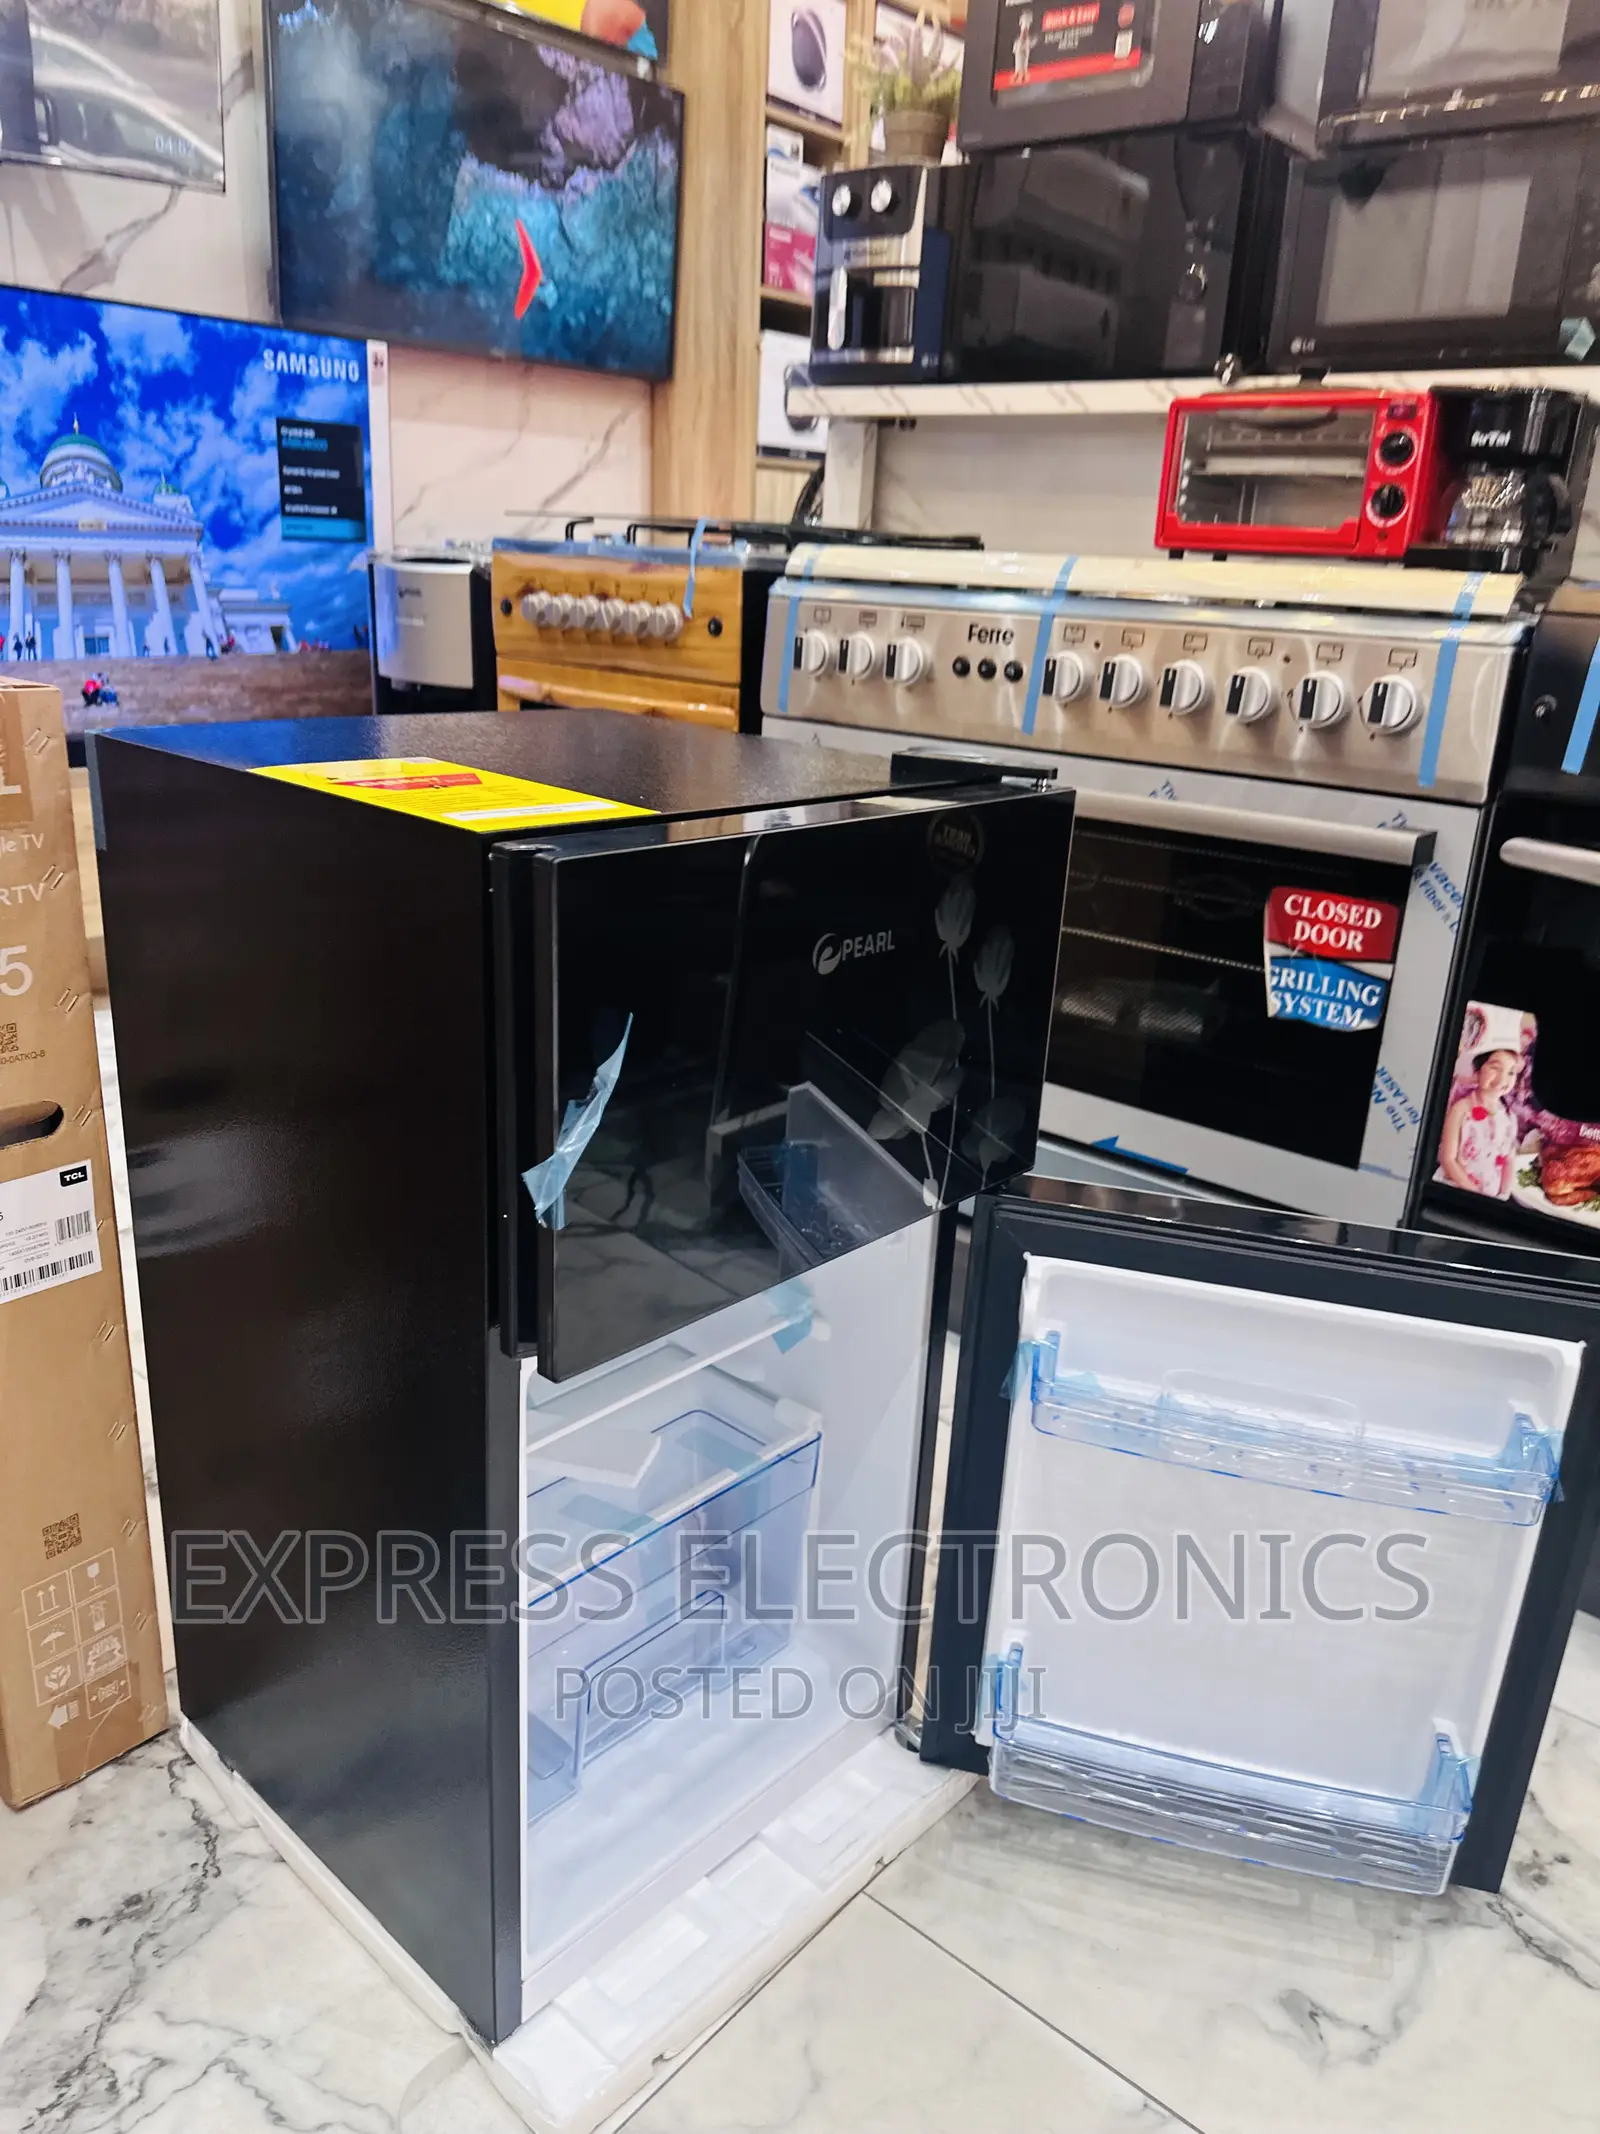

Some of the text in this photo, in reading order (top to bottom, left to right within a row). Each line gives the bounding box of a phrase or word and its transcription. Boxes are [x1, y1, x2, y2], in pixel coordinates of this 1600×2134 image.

[263, 348, 360, 383] SAMSUNG
[20, 833, 44, 850] TV
[1284, 894, 1382, 929] CLOSED
[841, 929, 896, 961] PEARL
[1293, 920, 1364, 953] DOOR
[1270, 965, 1382, 1008] GRILLING
[1269, 990, 1364, 1028] SYSTEM
[63, 1171, 85, 1182] TCL
